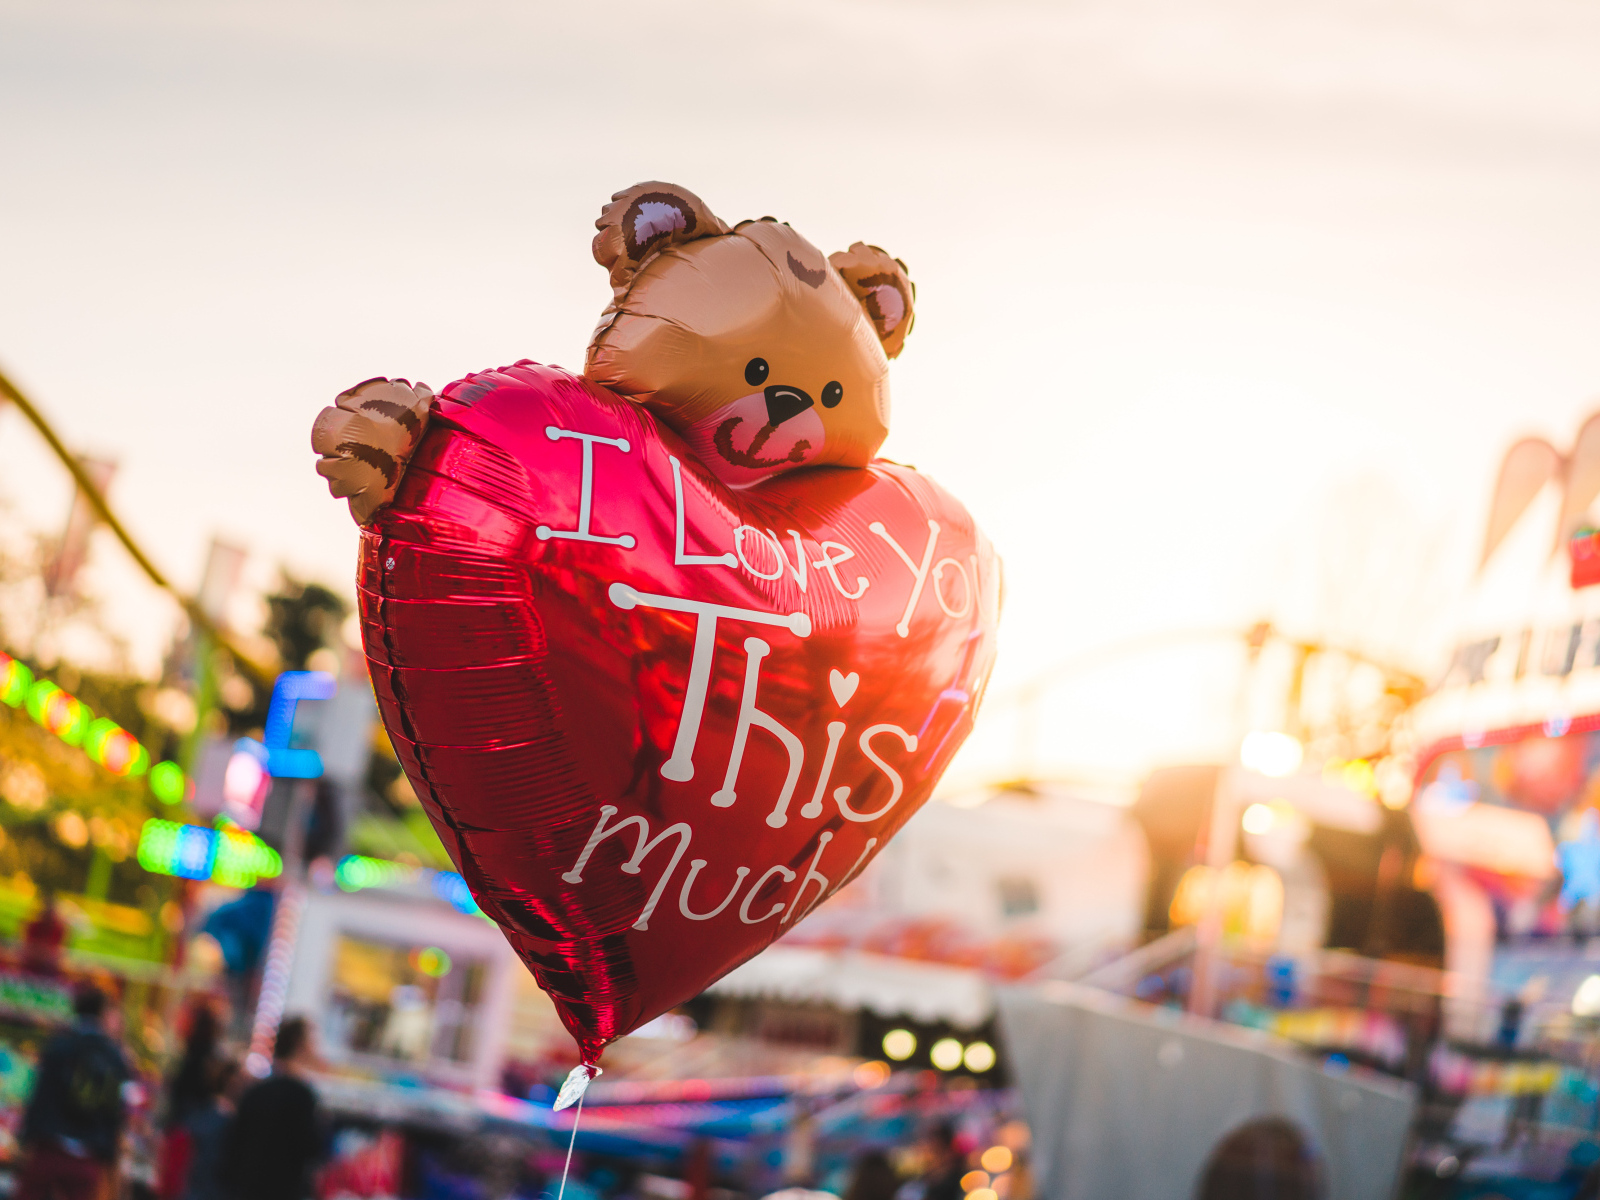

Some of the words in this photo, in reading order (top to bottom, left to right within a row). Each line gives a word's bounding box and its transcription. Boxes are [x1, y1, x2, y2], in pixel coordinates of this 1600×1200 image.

[535, 426, 635, 548] I
[669, 455, 869, 600] Love
[608, 582, 918, 829] This
